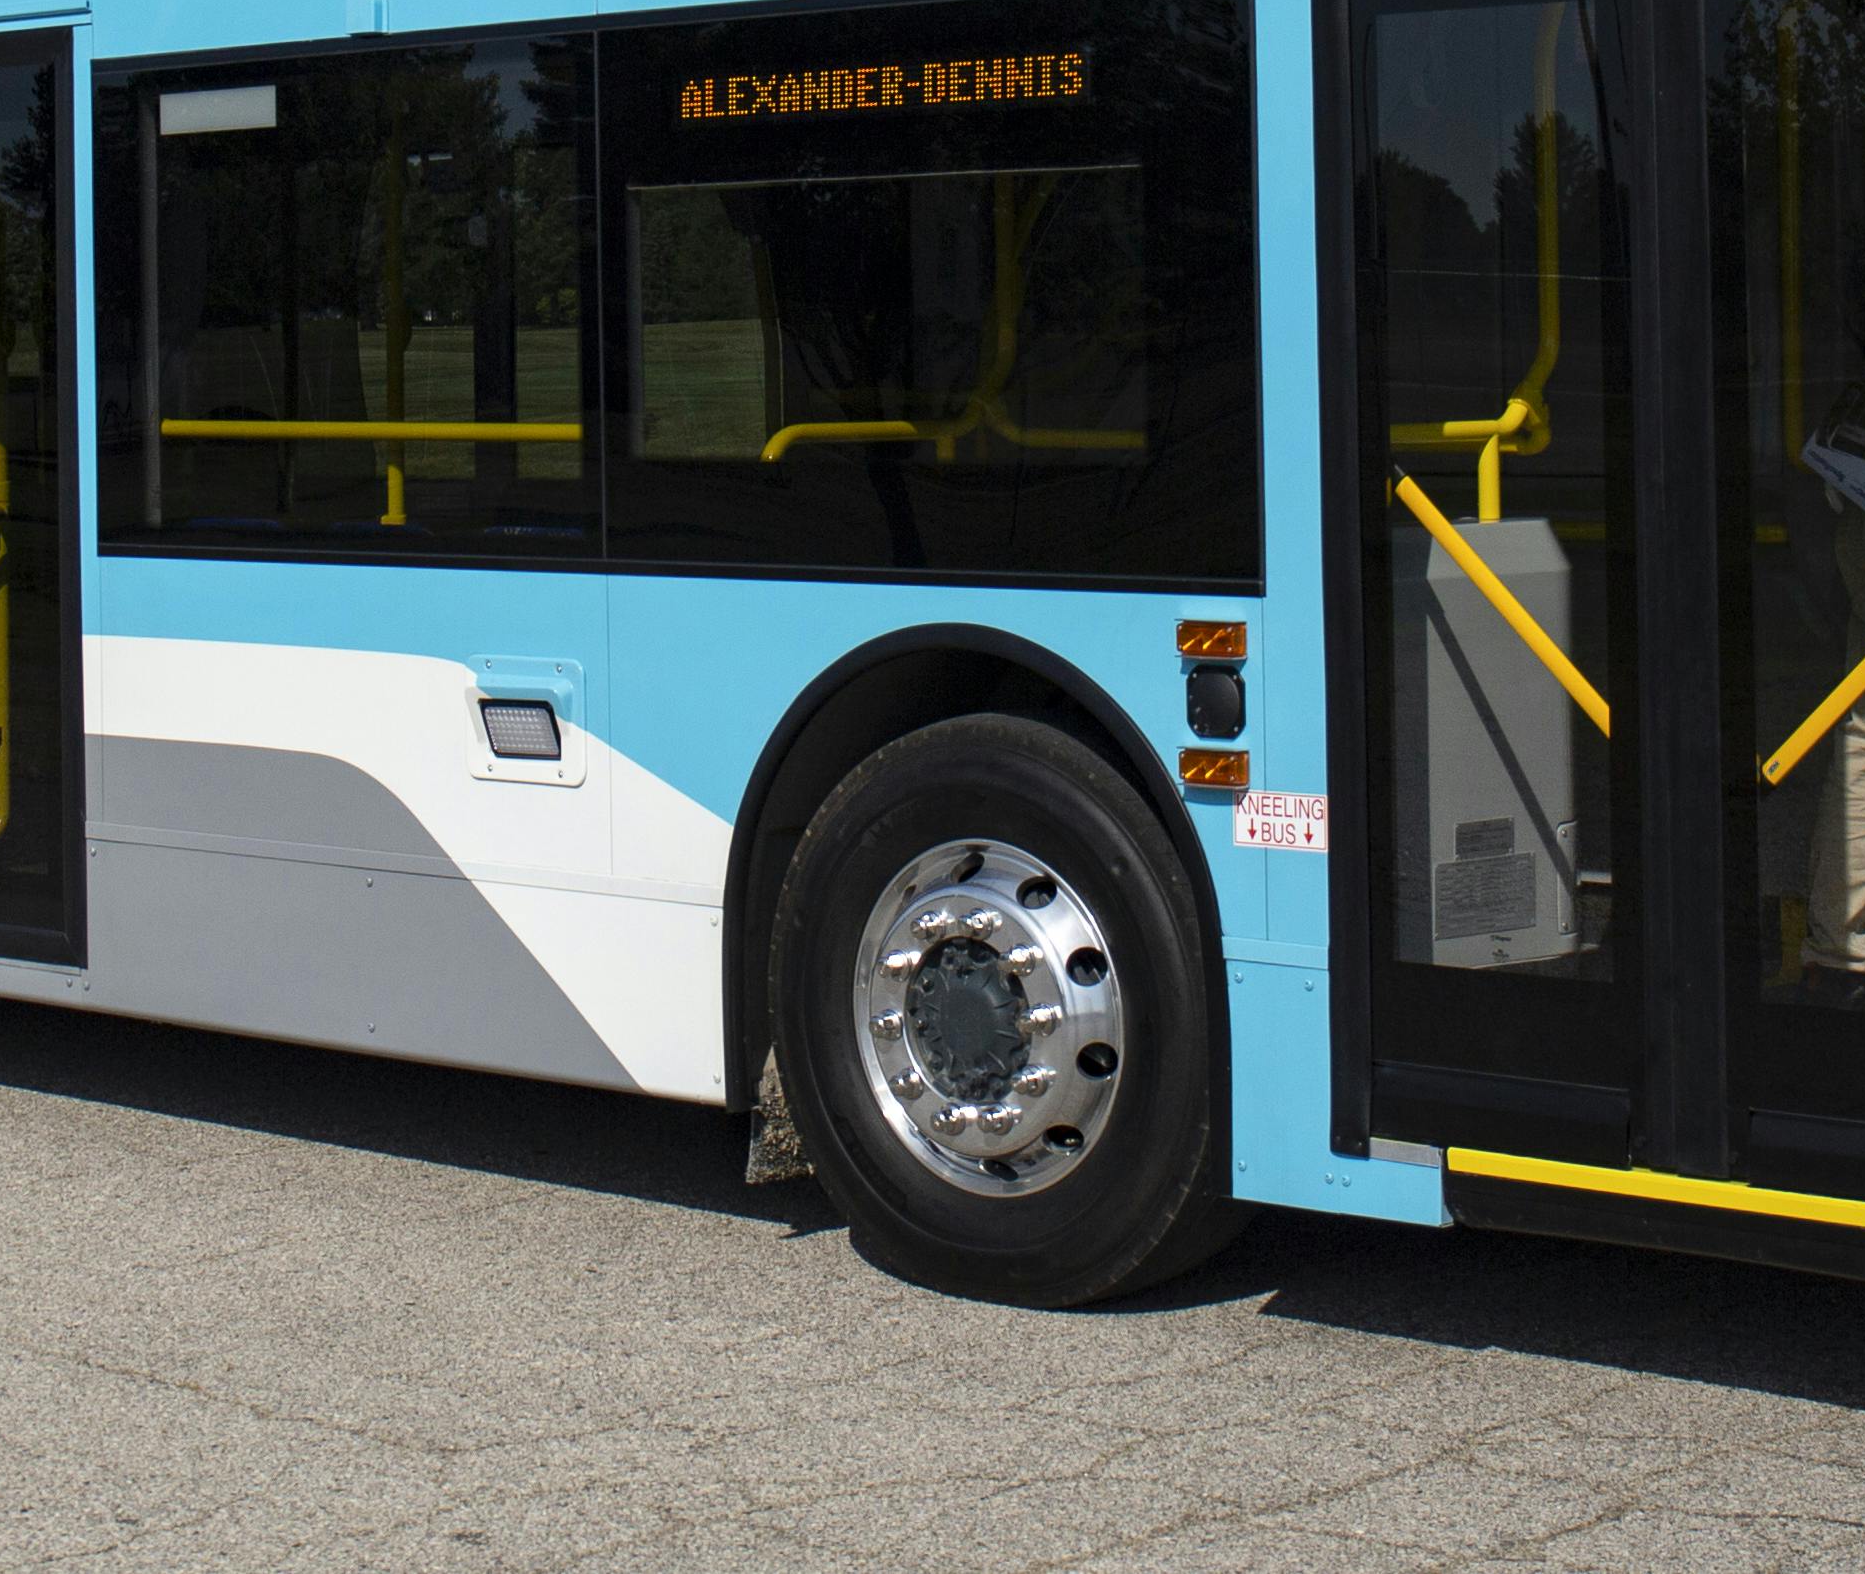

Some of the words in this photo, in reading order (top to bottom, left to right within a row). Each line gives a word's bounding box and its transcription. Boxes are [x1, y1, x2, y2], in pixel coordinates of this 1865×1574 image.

[681, 53, 1083, 119] ALEXANDER-DENNIS
[1236, 793, 1324, 820] KNEELING
[1261, 821, 1296, 845] BUS
